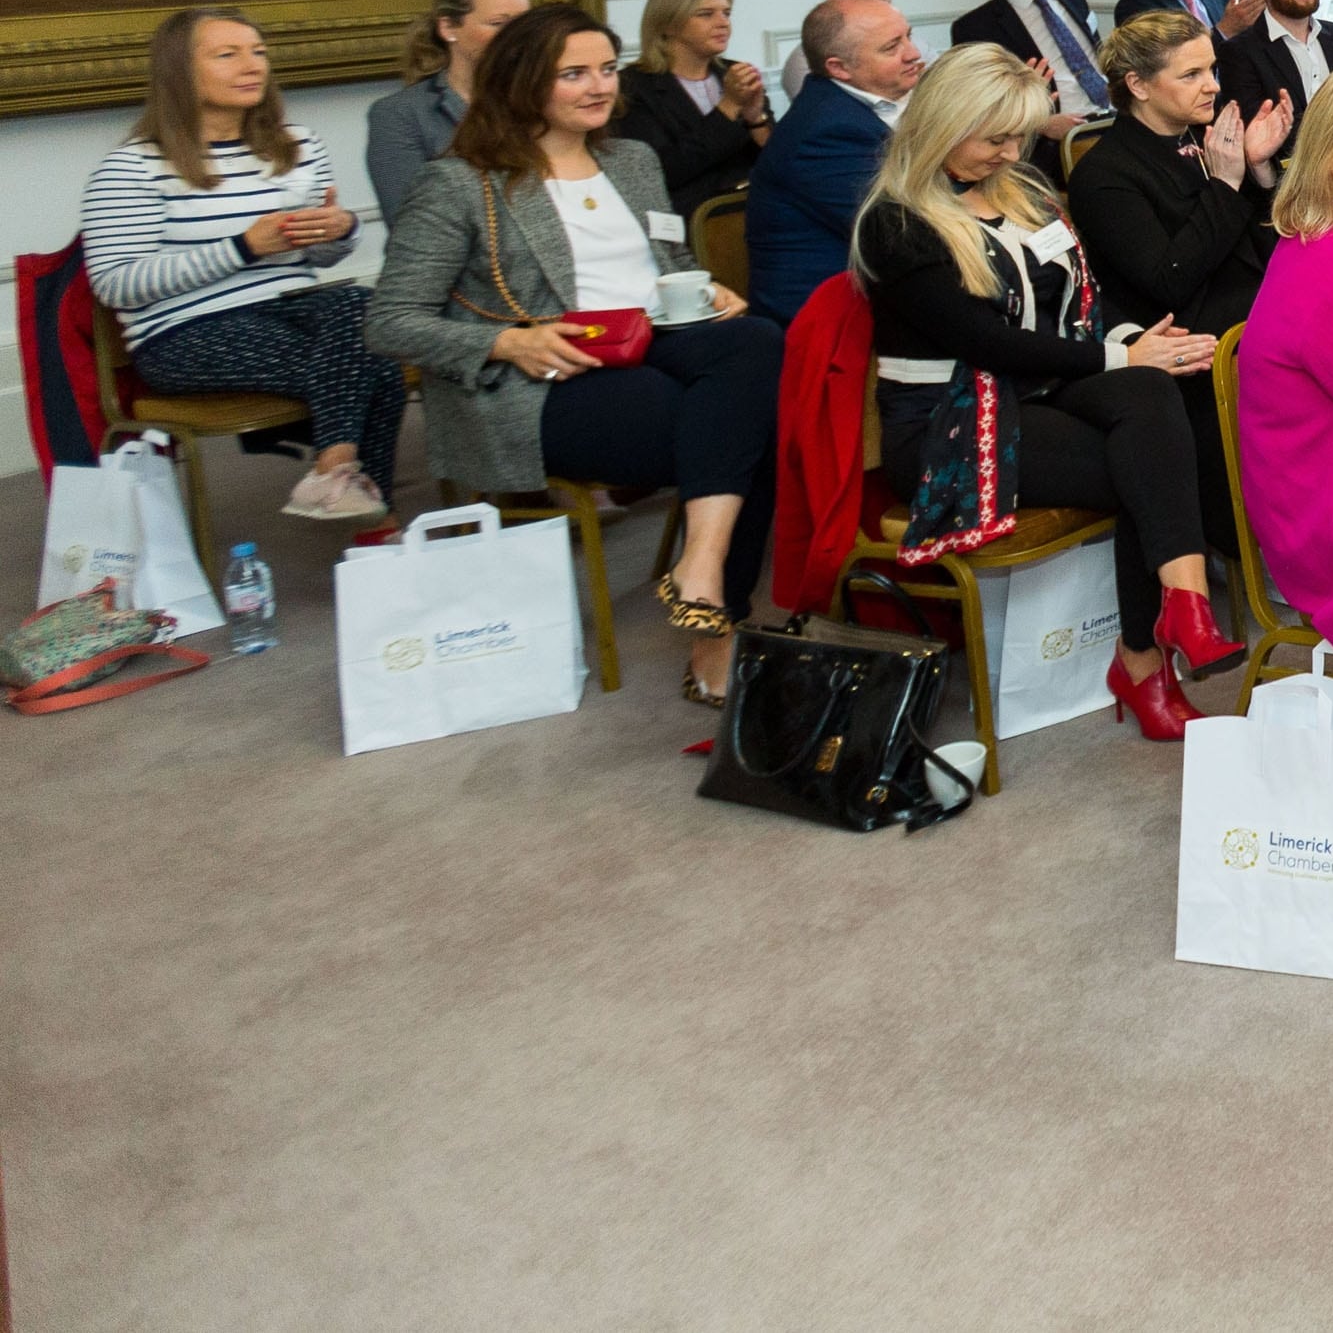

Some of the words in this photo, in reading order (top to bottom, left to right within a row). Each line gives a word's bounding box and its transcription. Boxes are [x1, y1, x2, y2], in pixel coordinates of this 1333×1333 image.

[1082, 611, 1120, 631] Limer
[1080, 624, 1121, 644] Cham
[1269, 831, 1333, 855] Limerick
